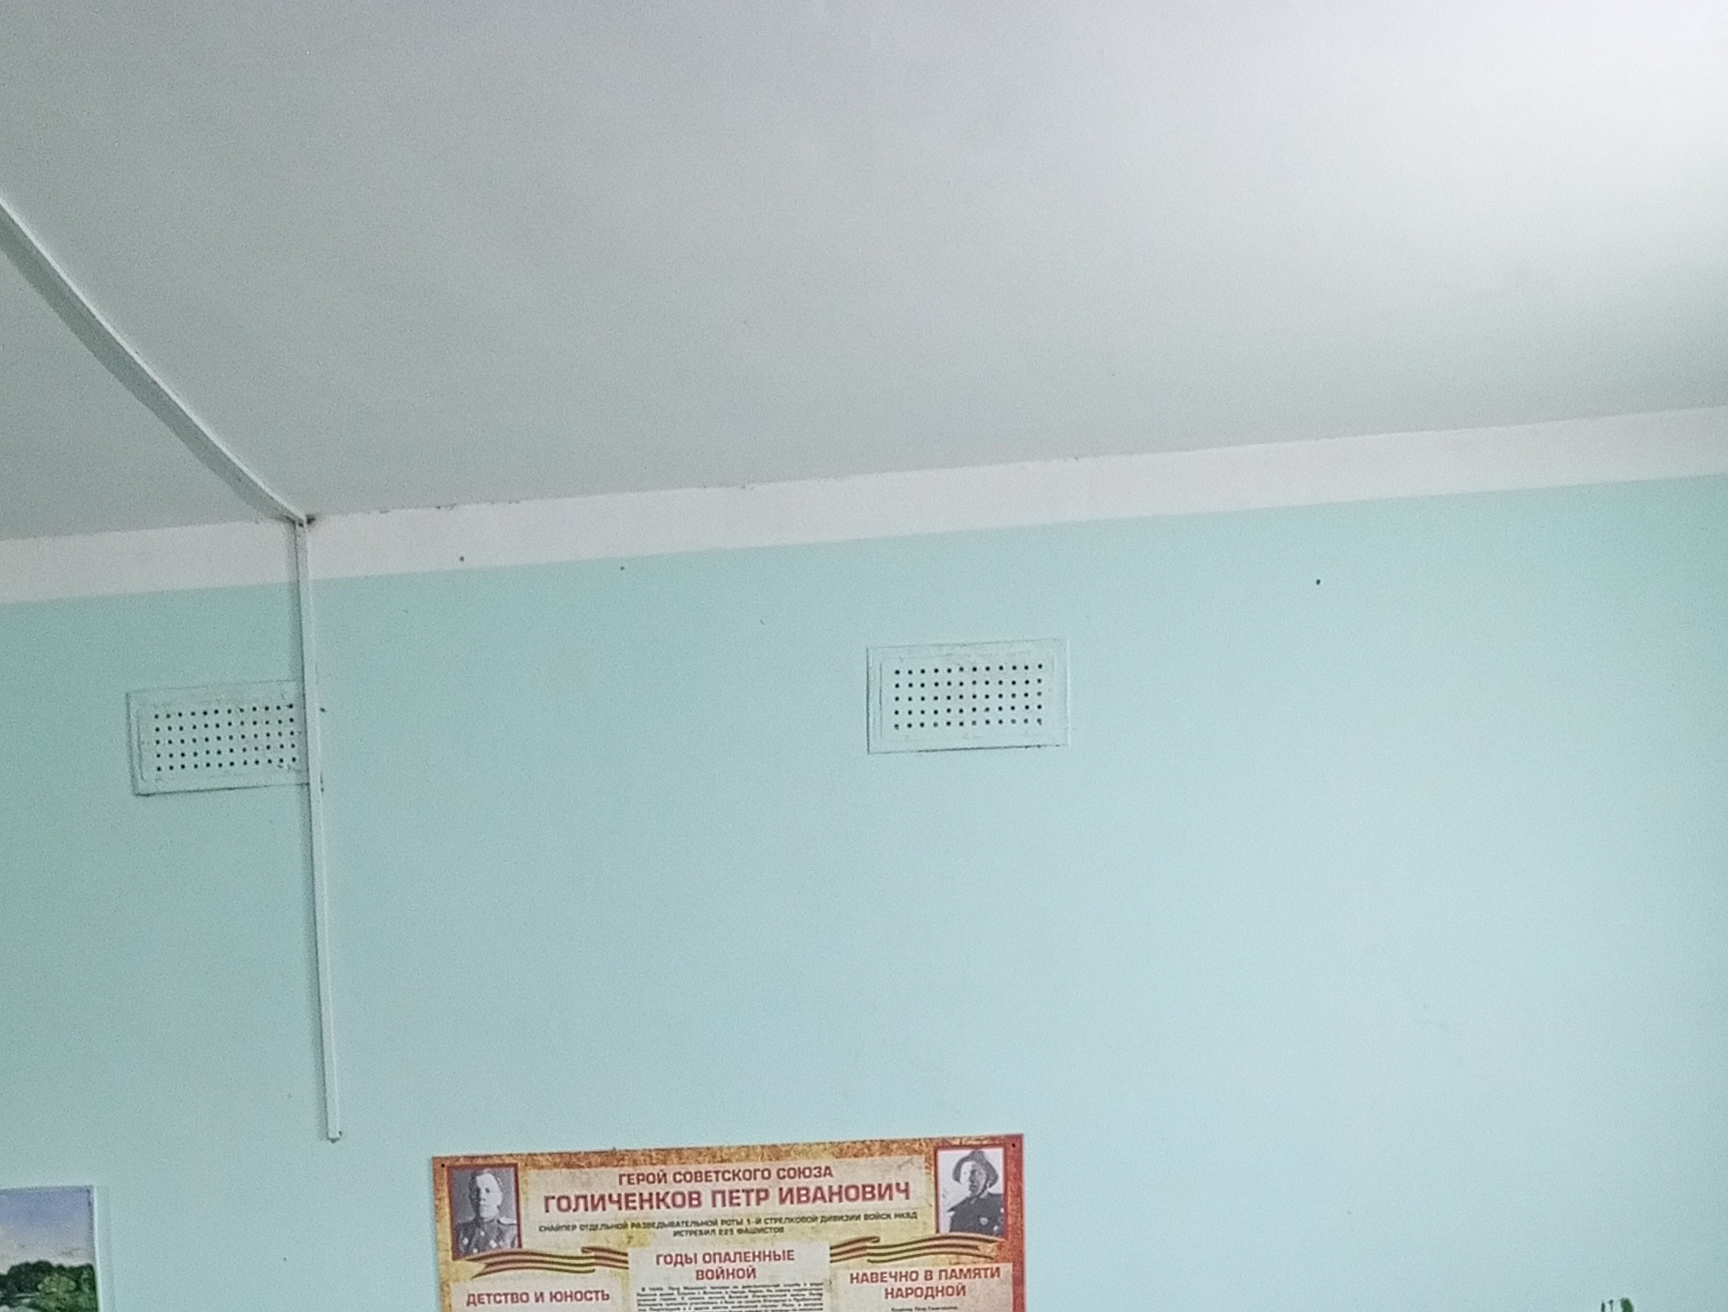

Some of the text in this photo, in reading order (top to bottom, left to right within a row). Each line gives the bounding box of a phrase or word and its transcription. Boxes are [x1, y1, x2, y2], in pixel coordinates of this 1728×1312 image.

[619, 1165, 833, 1186] ГЕРОЙ СОВЕТСКОГО СОЮЗА
[544, 1181, 911, 1213] ГОЛИЧЕНКОВ ПЕТР ИВАНОВИЧ
[539, 1223, 577, 1232] СНАЙПЕР
[579, 1221, 629, 1231] ОТДЕЛЬНОЙ
[631, 1218, 718, 1229] РАЗВЕДЫВАТЕЛЬНОЙ
[720, 1218, 743, 1227] РОТЫ
[764, 1214, 818, 1225] СТРЕЛКОВОЙ
[820, 1214, 861, 1224] ДИВИЗИИ
[863, 1212, 892, 1221] ВОЙСК
[736, 1226, 784, 1235] ФАШИСТОВ
[655, 1250, 795, 1267] ГОДЫ ОПАЛЕННЫЕ
[695, 1265, 757, 1281] ВОЙНОЙ
[850, 1266, 1001, 1284] НАВЕЧНО В ПАМЯТИ
[466, 1289, 610, 1307] ДЕТСТВО И ЮНОСТЬ
[884, 1282, 966, 1300] НАРОДНОЙ
